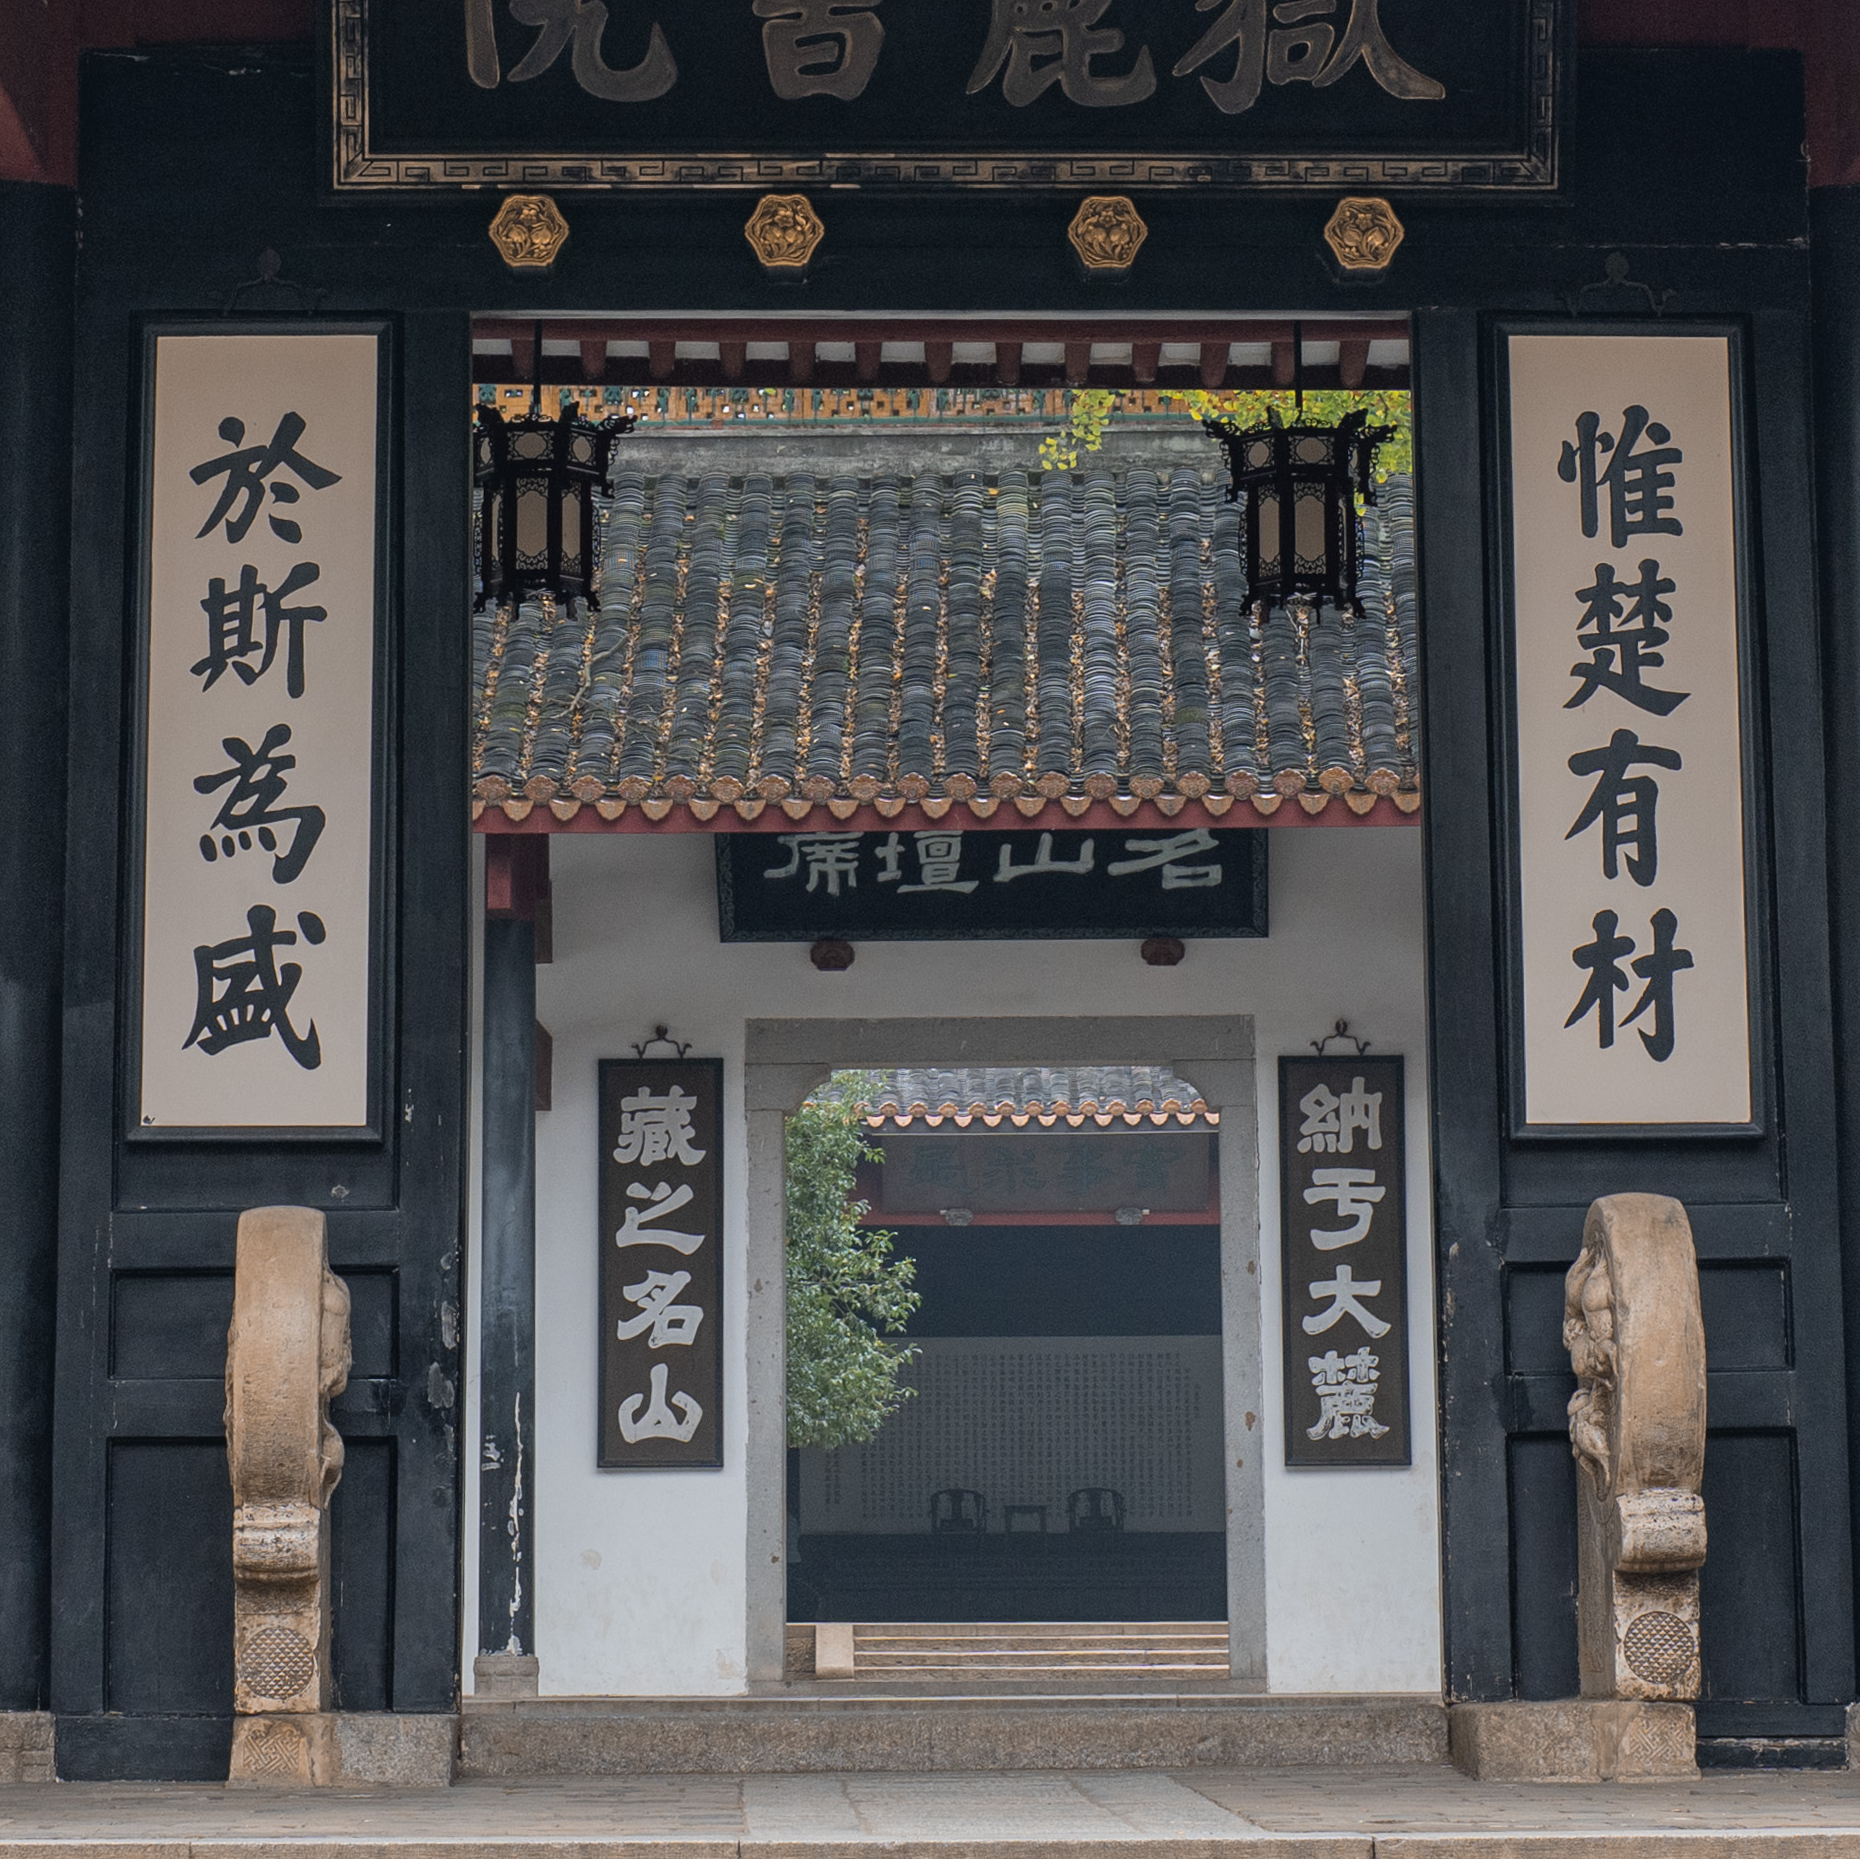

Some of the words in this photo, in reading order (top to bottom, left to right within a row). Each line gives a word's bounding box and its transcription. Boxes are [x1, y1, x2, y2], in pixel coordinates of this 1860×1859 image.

[182, 411, 342, 1071] 於斯為盛
[1557, 404, 1693, 1062] 惟楚有材
[613, 1084, 706, 1444] 藏之名山
